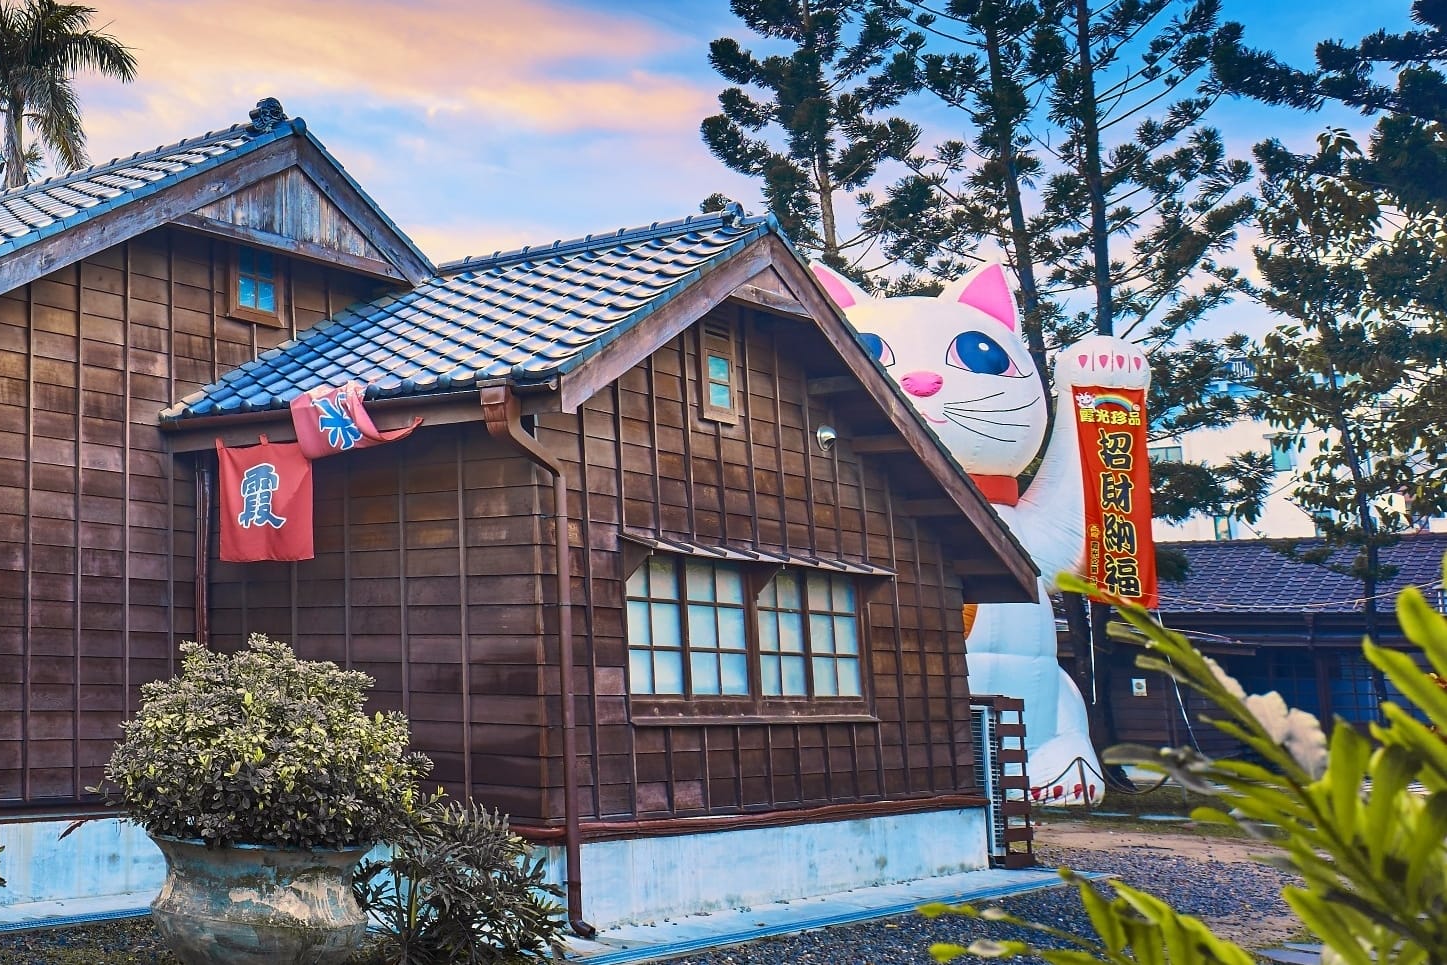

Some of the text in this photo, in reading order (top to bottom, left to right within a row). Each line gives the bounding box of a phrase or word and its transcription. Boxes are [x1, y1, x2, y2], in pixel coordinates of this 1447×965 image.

[1079, 408, 1141, 426] 霞光珍品
[238, 463, 287, 529] 霞
[1097, 427, 1142, 598] 招財納福
